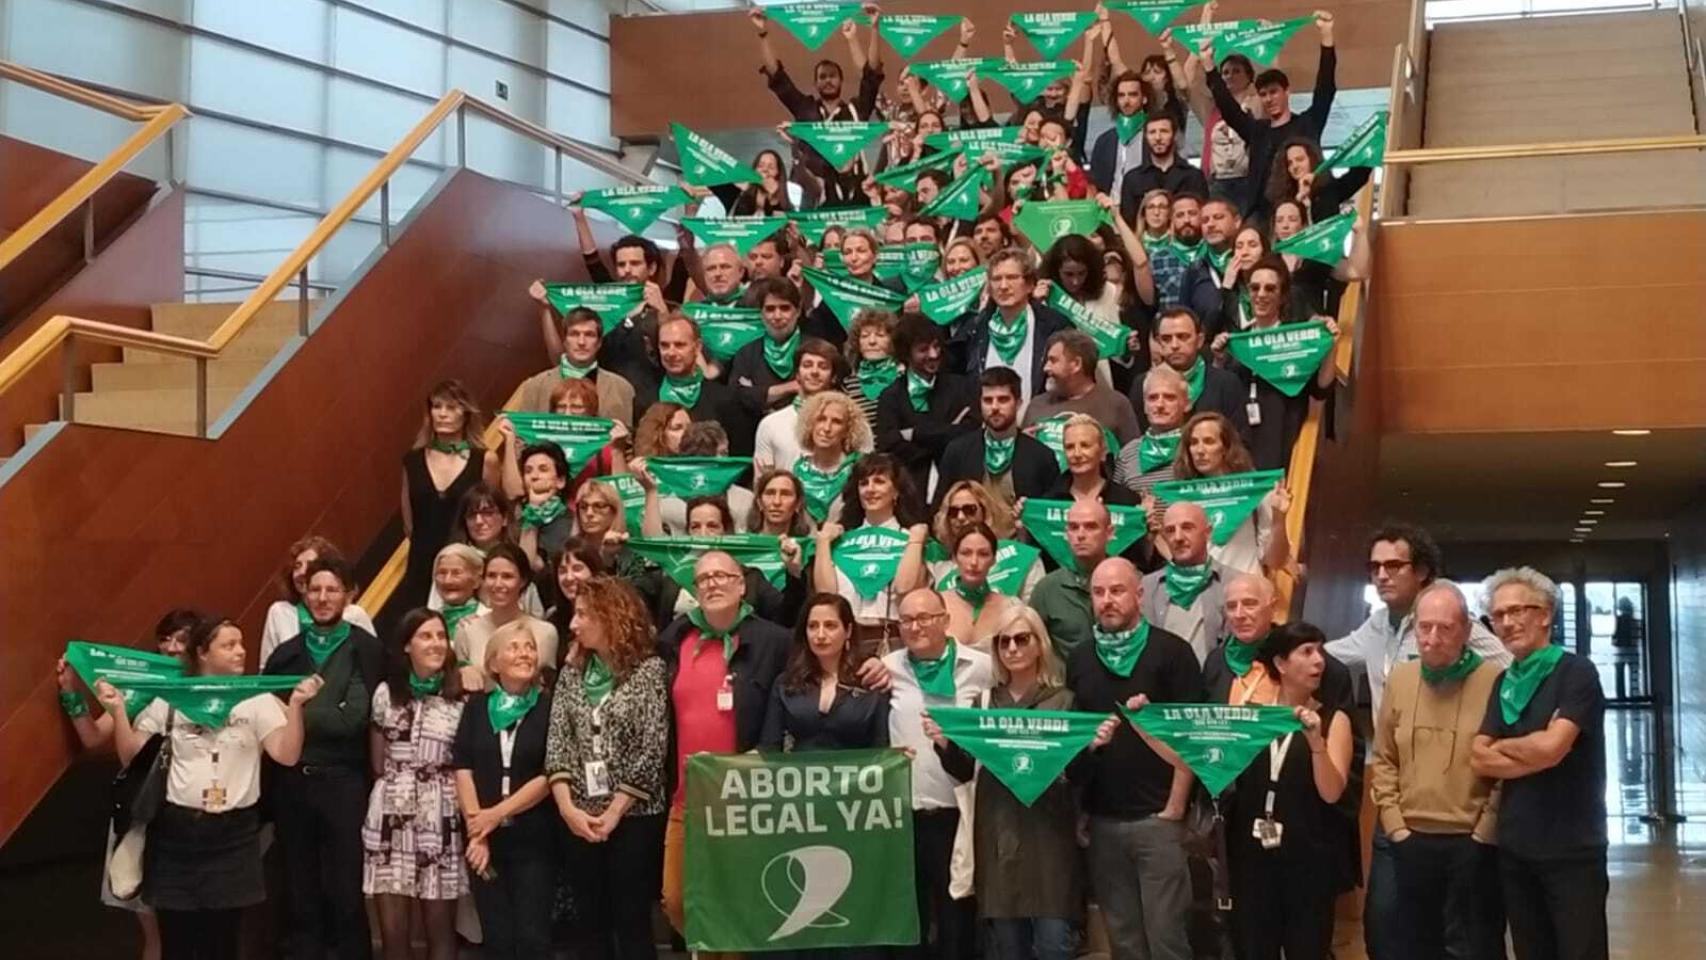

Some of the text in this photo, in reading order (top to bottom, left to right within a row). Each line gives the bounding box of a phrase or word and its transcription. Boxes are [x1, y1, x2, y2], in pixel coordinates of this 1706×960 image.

[1024, 13, 1034, 23] LA
[926, 290, 940, 302] LA
[940, 282, 958, 298] OLA
[1058, 293, 1072, 310] LA
[1071, 302, 1090, 320] OLA
[1249, 338, 1262, 348] LA
[1264, 333, 1285, 346] OLA
[1286, 328, 1321, 342] VERDE
[1047, 508, 1062, 521] LA
[979, 716, 996, 729] LA
[998, 716, 1024, 729] OLA
[1028, 717, 1070, 732] VERDE
[1163, 708, 1182, 720] LA
[1184, 707, 1211, 720] OLA
[1213, 706, 1260, 722] VERDE
[720, 764, 884, 800] ABORTO
[705, 797, 903, 836] LEGAL YA!
